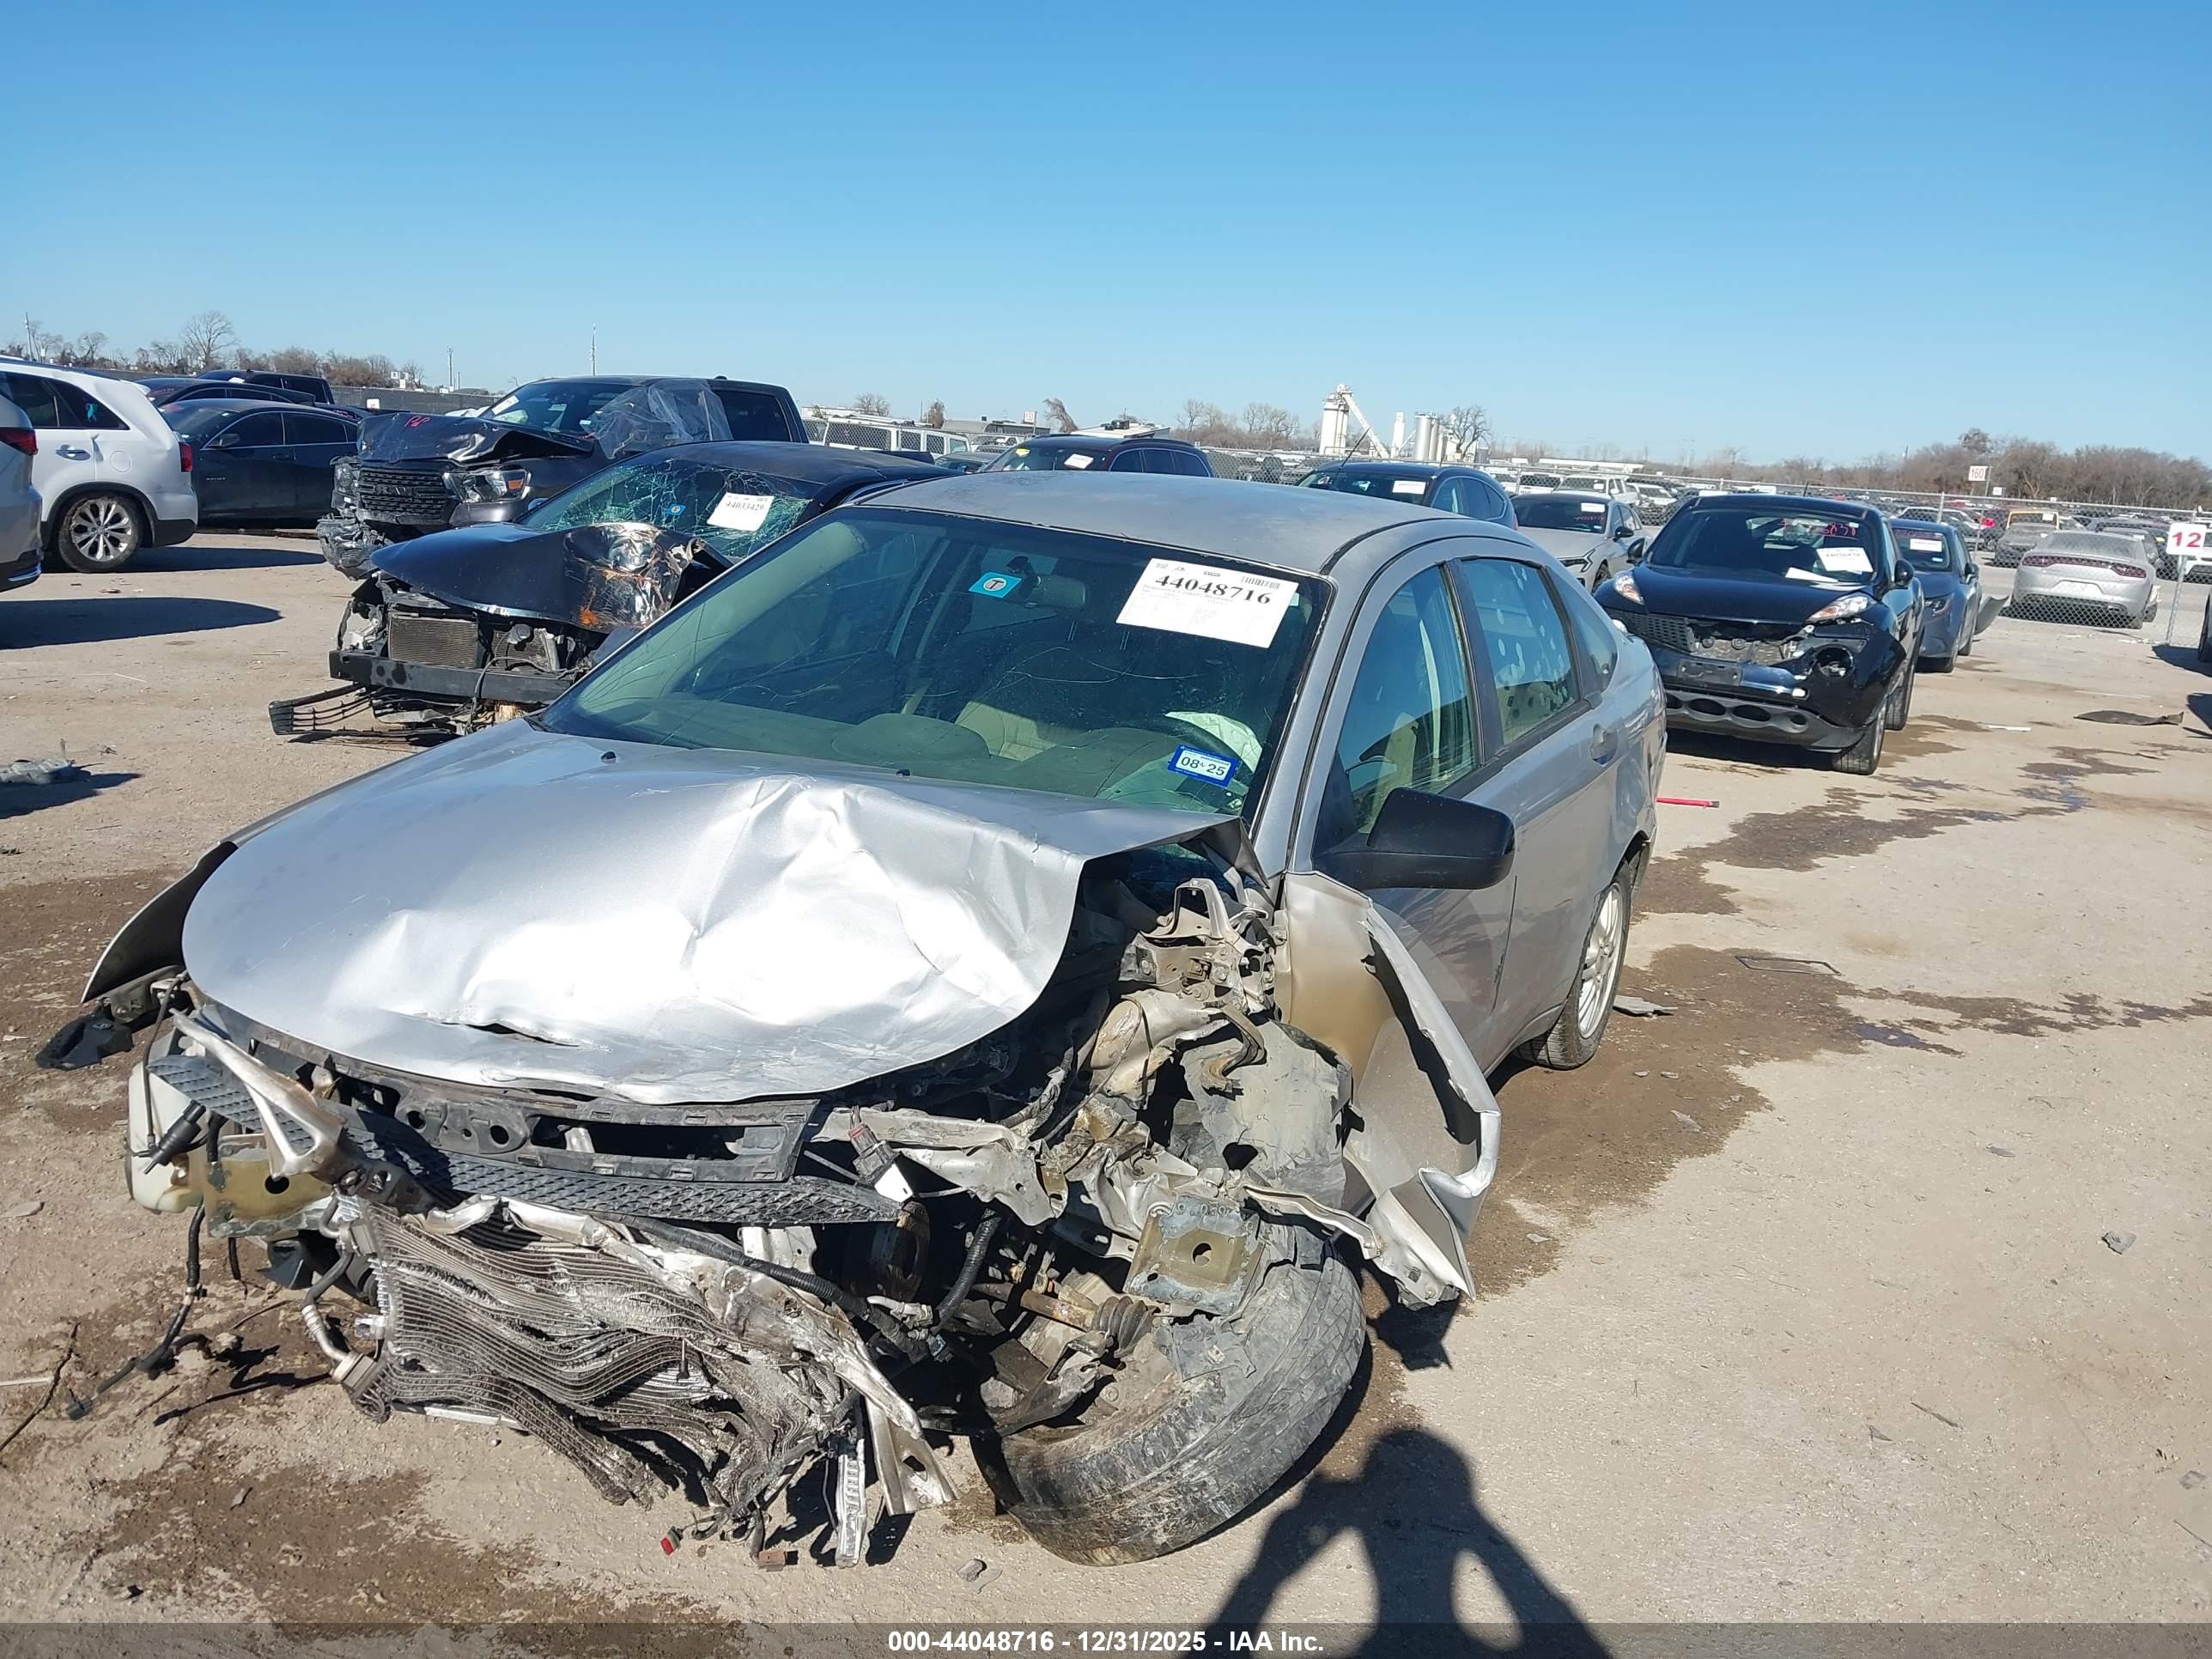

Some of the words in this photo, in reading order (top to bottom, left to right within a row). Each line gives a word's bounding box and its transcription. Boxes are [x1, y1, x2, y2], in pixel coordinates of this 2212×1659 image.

[1971, 468, 1984, 479] 160
[2172, 532, 2202, 548] 12
[1155, 574, 1273, 605] 44048716
